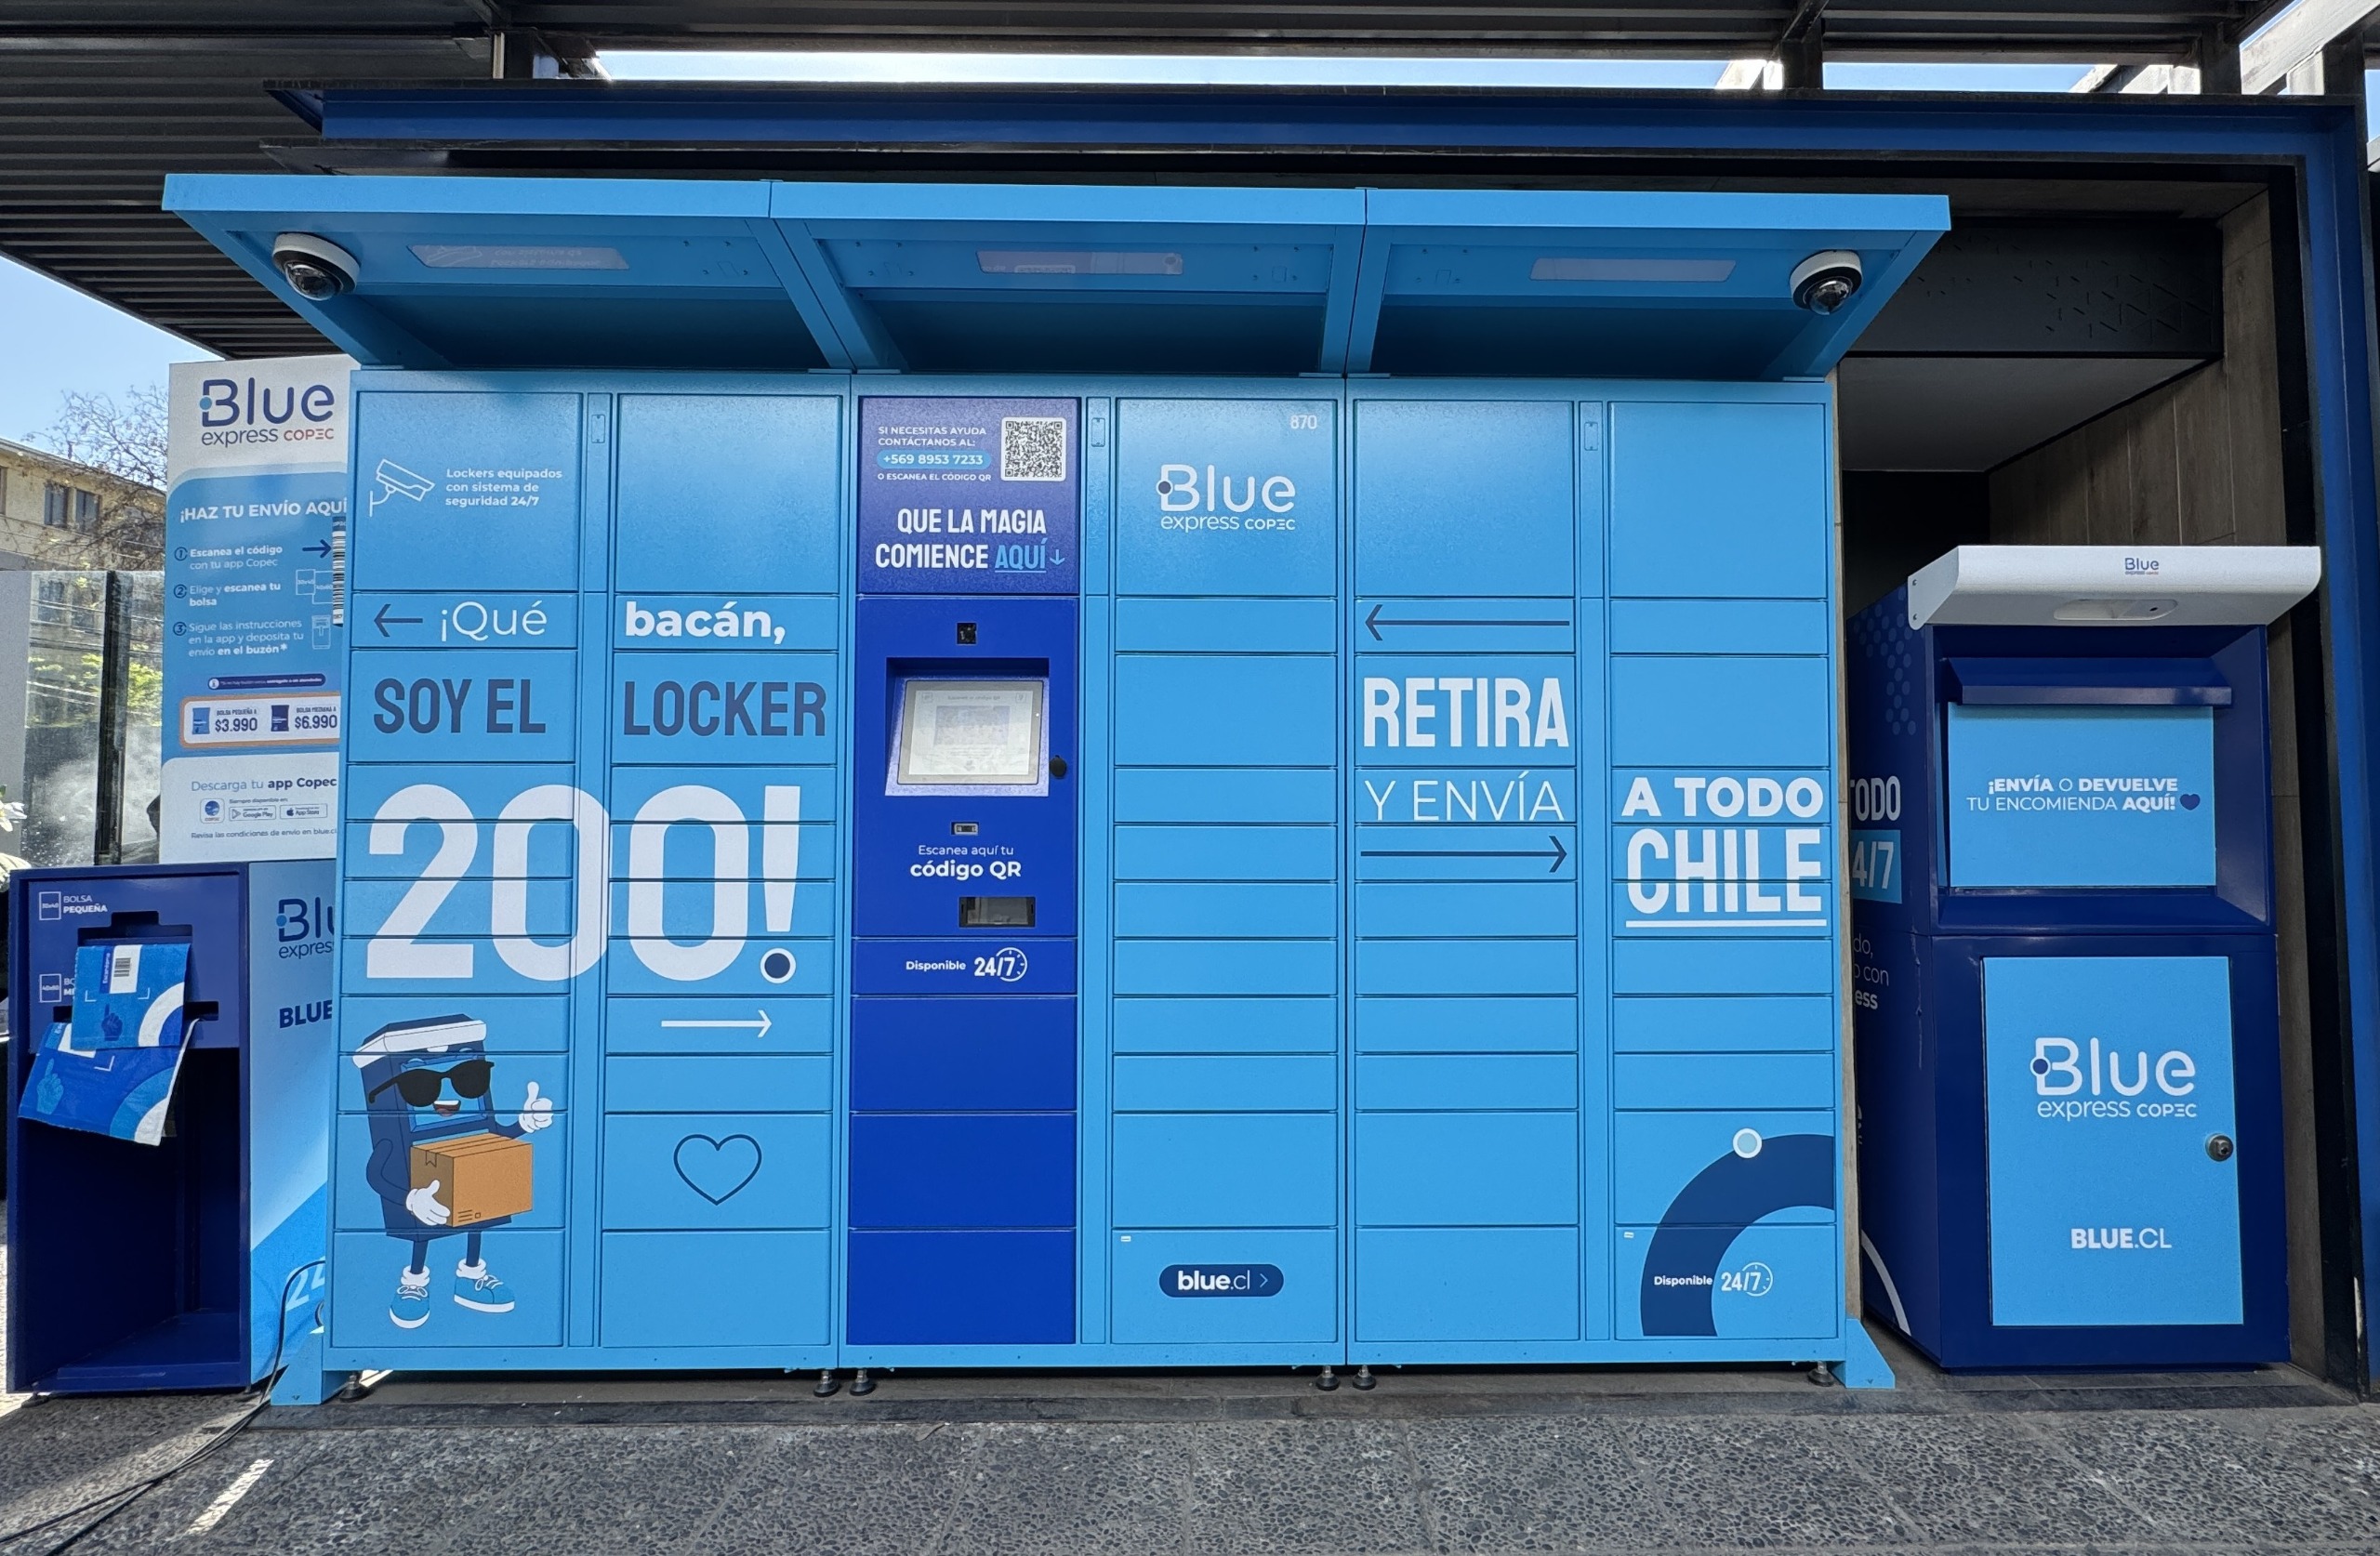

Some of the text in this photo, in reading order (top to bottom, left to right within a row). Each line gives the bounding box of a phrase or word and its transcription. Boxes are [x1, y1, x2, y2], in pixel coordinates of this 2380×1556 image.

[200, 376, 336, 428] Blue
[879, 427, 888, 435] SI
[891, 427, 947, 435] NECESITAS
[1290, 415, 1317, 429] 870
[202, 428, 335, 447] express COPEC
[878, 437, 975, 447] CONTÁCTANOS AL:
[883, 455, 984, 465] +569 8953 7233
[446, 468, 562, 481] Lockers equipados
[942, 472, 976, 481] CÓDIGO
[978, 474, 991, 482] QR
[446, 482, 539, 493] con sistema de
[1156, 464, 1295, 513] Blue
[445, 495, 539, 508] seguridad 24/7
[180, 506, 218, 523] ¡HAZ
[223, 505, 244, 518] TU
[249, 499, 301, 517] ENVÍO
[897, 508, 1047, 534] QUE LA MAGIA
[1161, 516, 1295, 533] express COPEC
[191, 546, 283, 558] Escanea el código
[876, 538, 1048, 570] COMIENCE AQUÍ
[224, 560, 244, 570] app
[246, 559, 278, 568] Copec
[2124, 558, 2159, 571] Blue
[190, 583, 281, 596] Elige y escanea tu
[190, 598, 217, 606] bolsa
[188, 619, 303, 633] Sigue las instrucciones
[442, 600, 787, 645] ¡Qué bacán,
[188, 632, 304, 645] en la app y deposita tu
[233, 646, 243, 654] el
[374, 678, 826, 736] SOY EL LOCKER
[1363, 678, 1569, 747] RETIRA
[215, 718, 258, 732] $3.990
[295, 715, 337, 730] $6.990
[192, 777, 337, 792] Descarga tu app Copec
[1989, 774, 2178, 795] ¡ENVÍA O DEVUELVE
[1364, 771, 1824, 822] Y ENVÍA A TODO
[1966, 793, 2175, 813] TU ENCOMIENDA AQUÍ!
[919, 844, 1014, 857] Escanea aquí tu
[910, 860, 1022, 880] código QR
[1626, 828, 1822, 914] CHILE
[366, 784, 800, 984] 200!
[63, 895, 93, 903] BOLSA
[63, 903, 108, 915] PEQUEÑA
[279, 941, 335, 959] expres
[906, 957, 1016, 977] Disponible 24/7
[1863, 966, 1889, 987] con
[1855, 989, 1878, 1010] ess
[2030, 1036, 2196, 1097] Blue
[2037, 1101, 2198, 1122] express COPEC
[2070, 1228, 2173, 1249] BLUE.CL
[1178, 1270, 1250, 1290] blue.cl
[1654, 1272, 1762, 1292] Disponible 24/7
